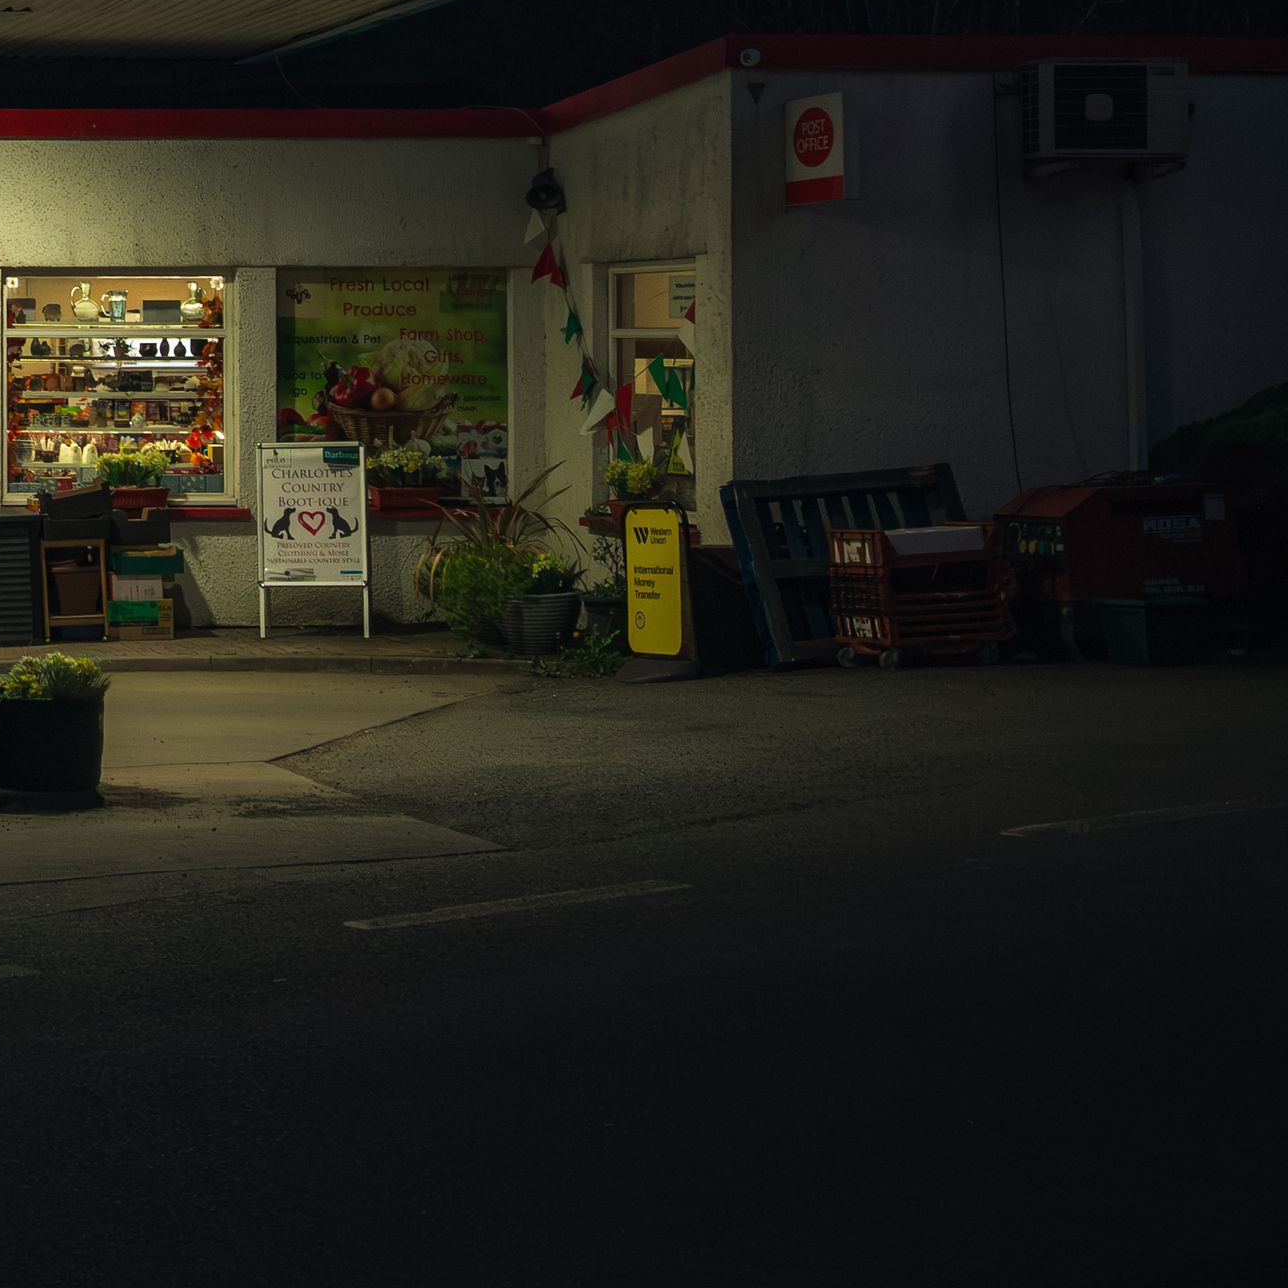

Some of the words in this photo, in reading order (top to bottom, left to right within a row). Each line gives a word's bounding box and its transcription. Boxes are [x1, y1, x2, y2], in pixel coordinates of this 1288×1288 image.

[801, 118, 826, 135] POST
[797, 135, 829, 153] OFFICE
[330, 277, 375, 292] Fresh
[382, 277, 430, 292] Local
[342, 302, 417, 317] Produce
[351, 334, 360, 344] &
[363, 335, 381, 344] Pet
[399, 328, 439, 341] Farm
[400, 372, 488, 386] Homeware
[324, 450, 359, 461] Barbour
[281, 482, 344, 493] COUNTRY
[278, 497, 350, 508] BOOT-IQUE
[650, 527, 672, 536] Western
[650, 536, 667, 544] Union
[633, 565, 674, 575] International
[634, 578, 656, 588] Money
[634, 590, 662, 600] Transfer
